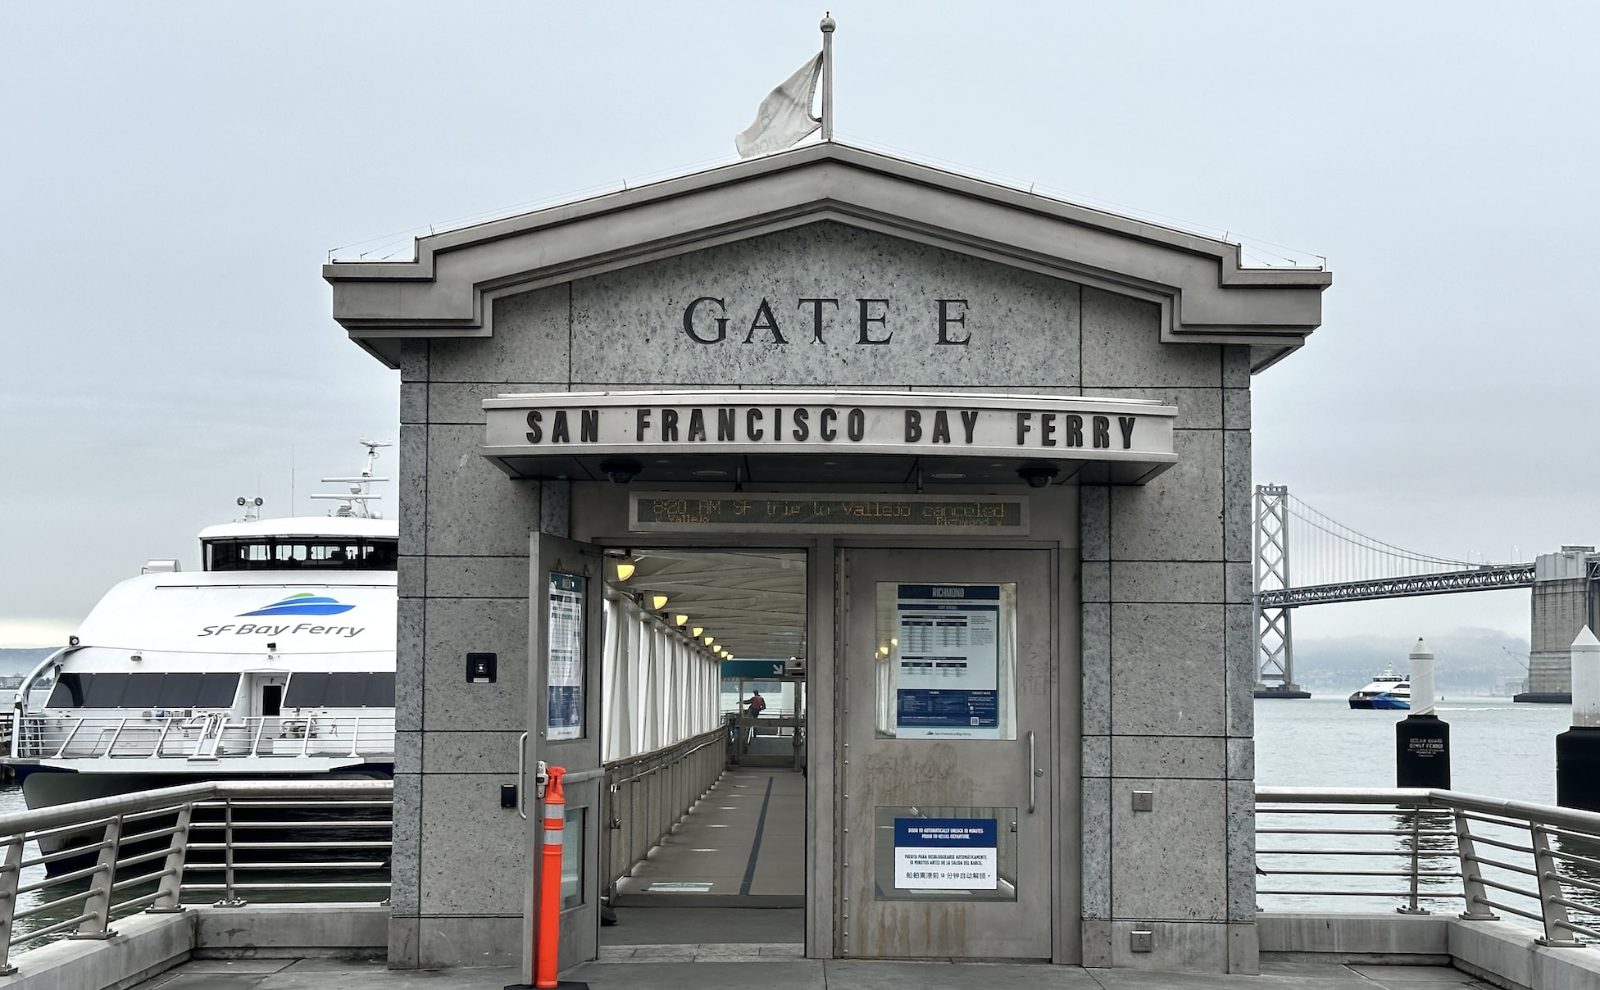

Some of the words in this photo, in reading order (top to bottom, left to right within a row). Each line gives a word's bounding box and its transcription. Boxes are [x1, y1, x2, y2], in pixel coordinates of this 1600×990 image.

[683, 297, 893, 345] GATE
[934, 299, 972, 346] E
[526, 409, 600, 443] SAN
[636, 408, 866, 442] FRANCISCO
[906, 409, 979, 445] BAY
[1017, 412, 1137, 449] FERRY
[733, 500, 752, 516] SF
[842, 501, 911, 518] Vallejo
[922, 501, 1005, 519] canceled
[932, 587, 965, 598] RICHMOND
[197, 624, 236, 637] SF
[235, 623, 290, 637] Bay
[292, 623, 366, 638] Ferry
